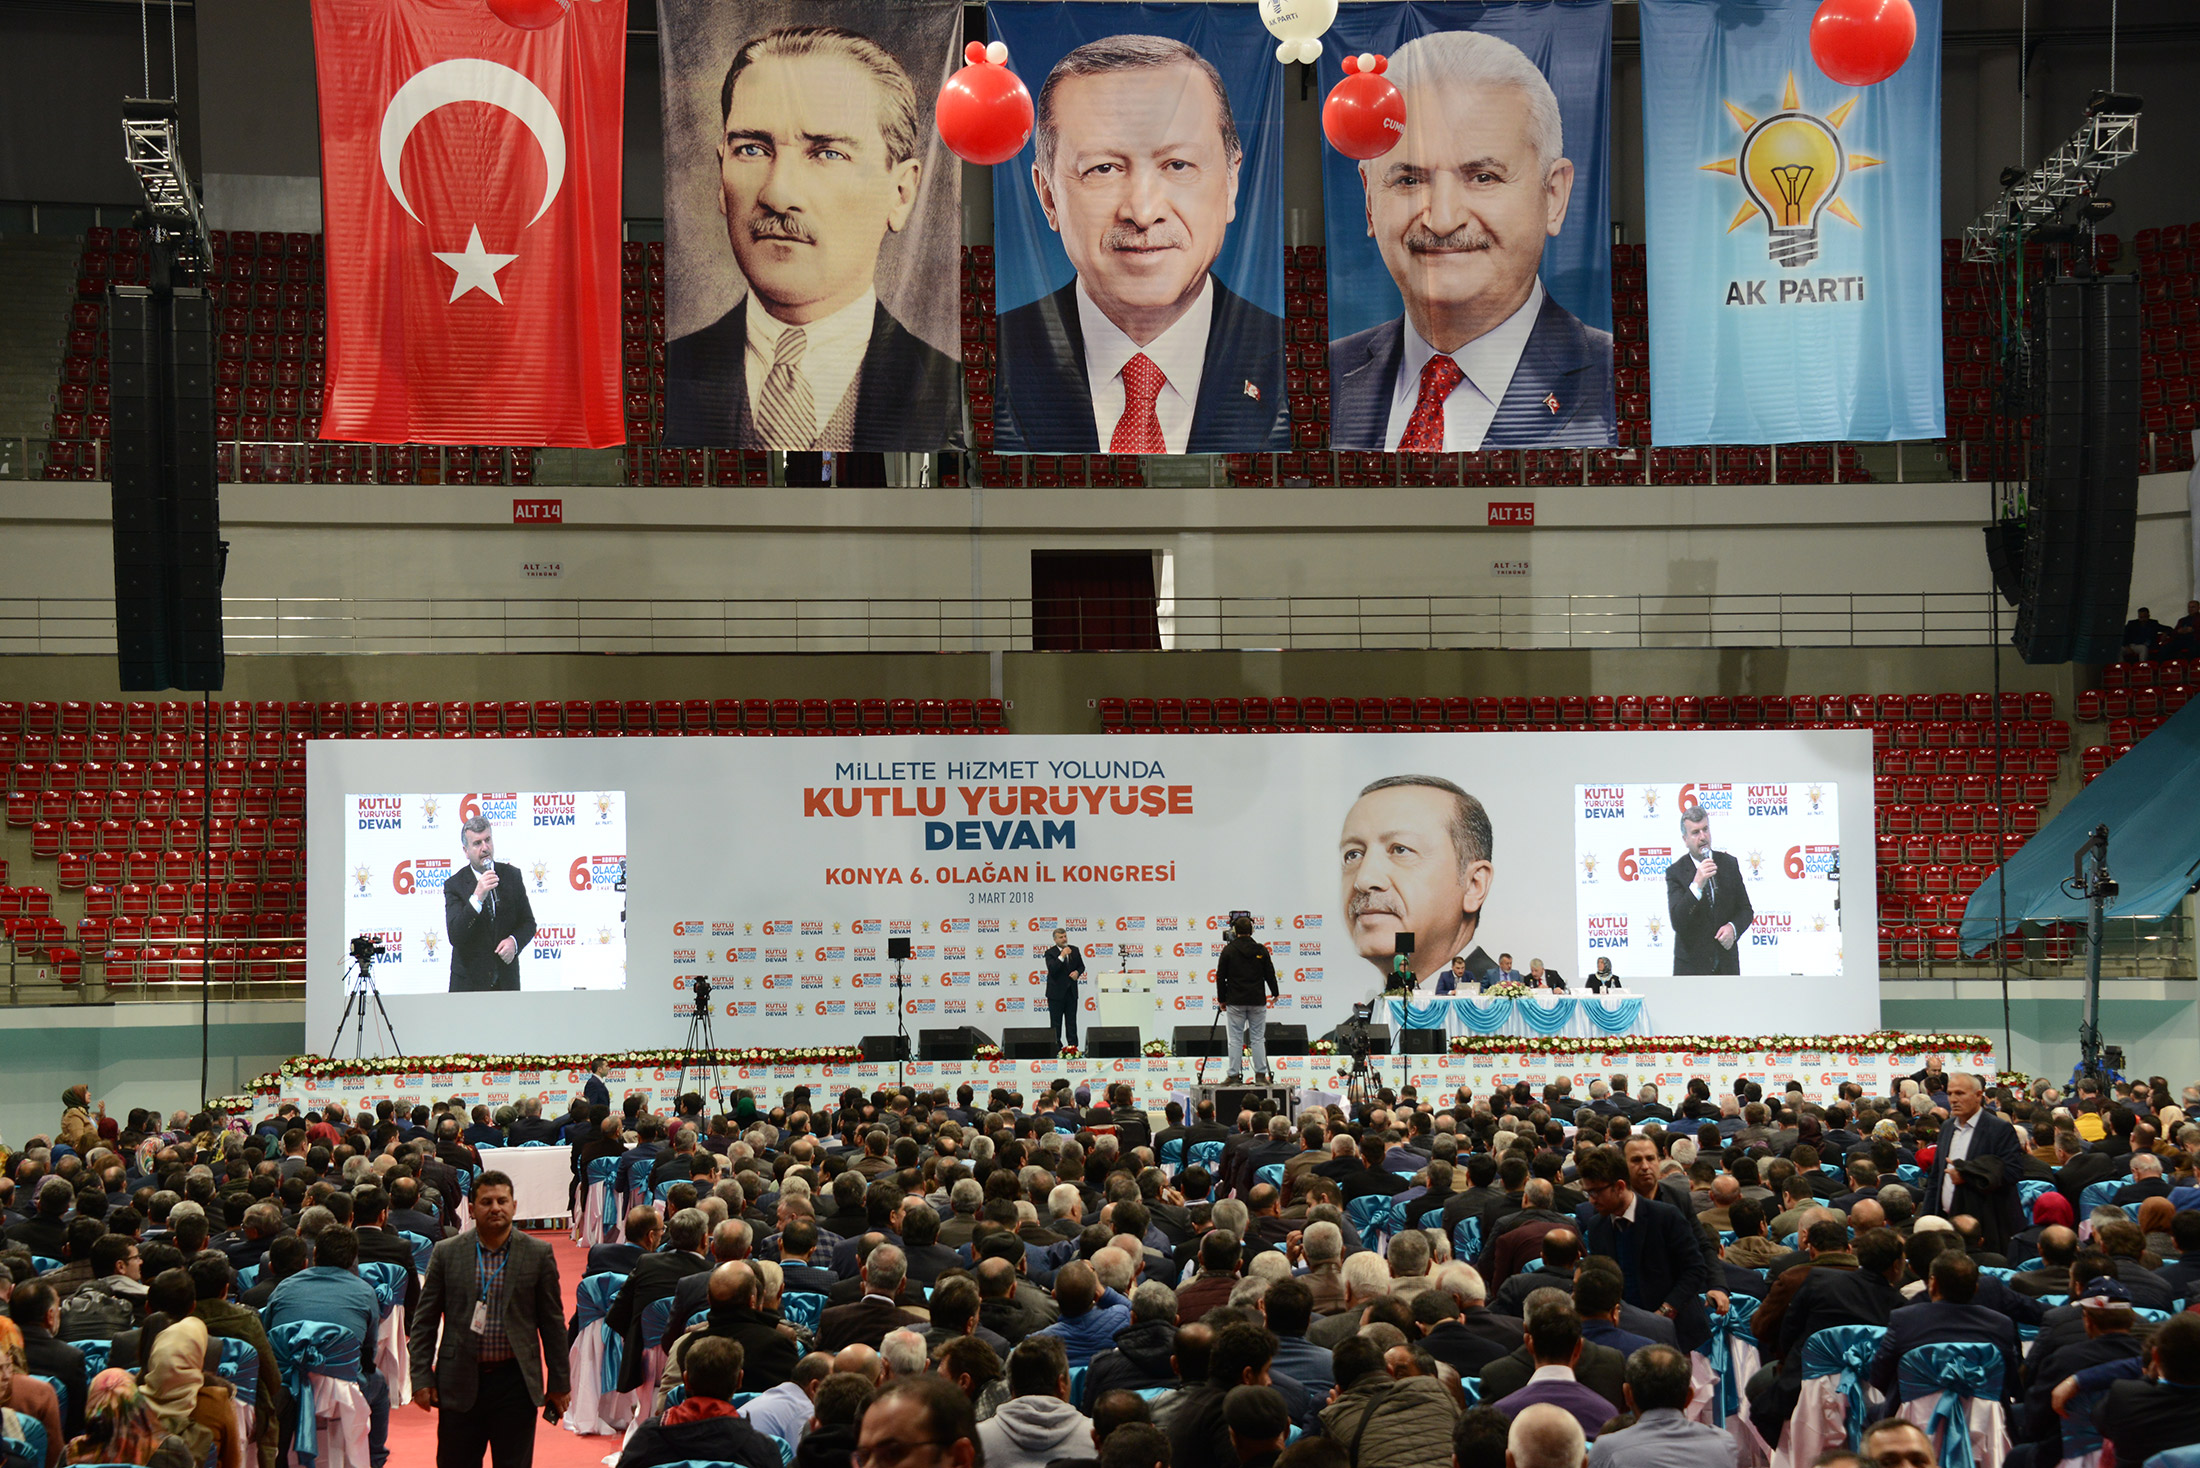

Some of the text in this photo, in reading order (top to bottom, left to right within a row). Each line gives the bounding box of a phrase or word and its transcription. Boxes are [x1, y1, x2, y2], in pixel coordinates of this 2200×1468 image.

[1725, 280, 1767, 306] AK
[516, 504, 560, 518] ALT 14
[1490, 508, 1532, 520] ALT 15
[1048, 760, 1166, 778] YOLUNDA
[1584, 788, 1624, 800] KUTLU
[1748, 785, 1788, 796] KUTLU
[358, 798, 402, 810] KUTLU
[482, 800, 517, 810] OLAĞAN
[534, 795, 575, 806] KUTLU
[803, 785, 1193, 818] KUTLU YÜRÜYÜŞE
[1700, 800, 1732, 810] KONGRE
[482, 810, 517, 820] KONGRE
[1585, 808, 1624, 818] DEVAM
[1748, 805, 1788, 816] DEVAM
[358, 818, 402, 830] DEVAM
[534, 815, 575, 826] DEVAM
[924, 820, 1076, 850] DEVAM
[1784, 845, 1806, 880] 6.
[1806, 854, 1834, 864] OLAĞA
[592, 864, 622, 875] OLAĞA
[1618, 848, 1640, 882] 6.
[1639, 866, 1666, 875] KONGR
[1806, 864, 1834, 872] KONGR
[393, 860, 416, 895] 6.
[416, 868, 452, 878] OLAĞAN
[569, 856, 592, 891] 6.
[825, 868, 903, 885] KONYA
[909, 867, 929, 884] 6.
[936, 860, 1029, 884] OLAĞAN
[1062, 860, 1176, 883] KONGRESİ
[416, 878, 445, 888] KONGR
[592, 875, 622, 884] KONGR
[968, 892, 1034, 904] 3 MART 2018
[1588, 917, 1628, 928] KUTLU
[1752, 915, 1791, 926] KUTLU
[534, 928, 576, 939] KUTLU
[1589, 937, 1628, 948] DEVAM
[1752, 935, 1778, 946] DEV
[370, 952, 402, 964] EVAM
[534, 948, 562, 959] DEV
